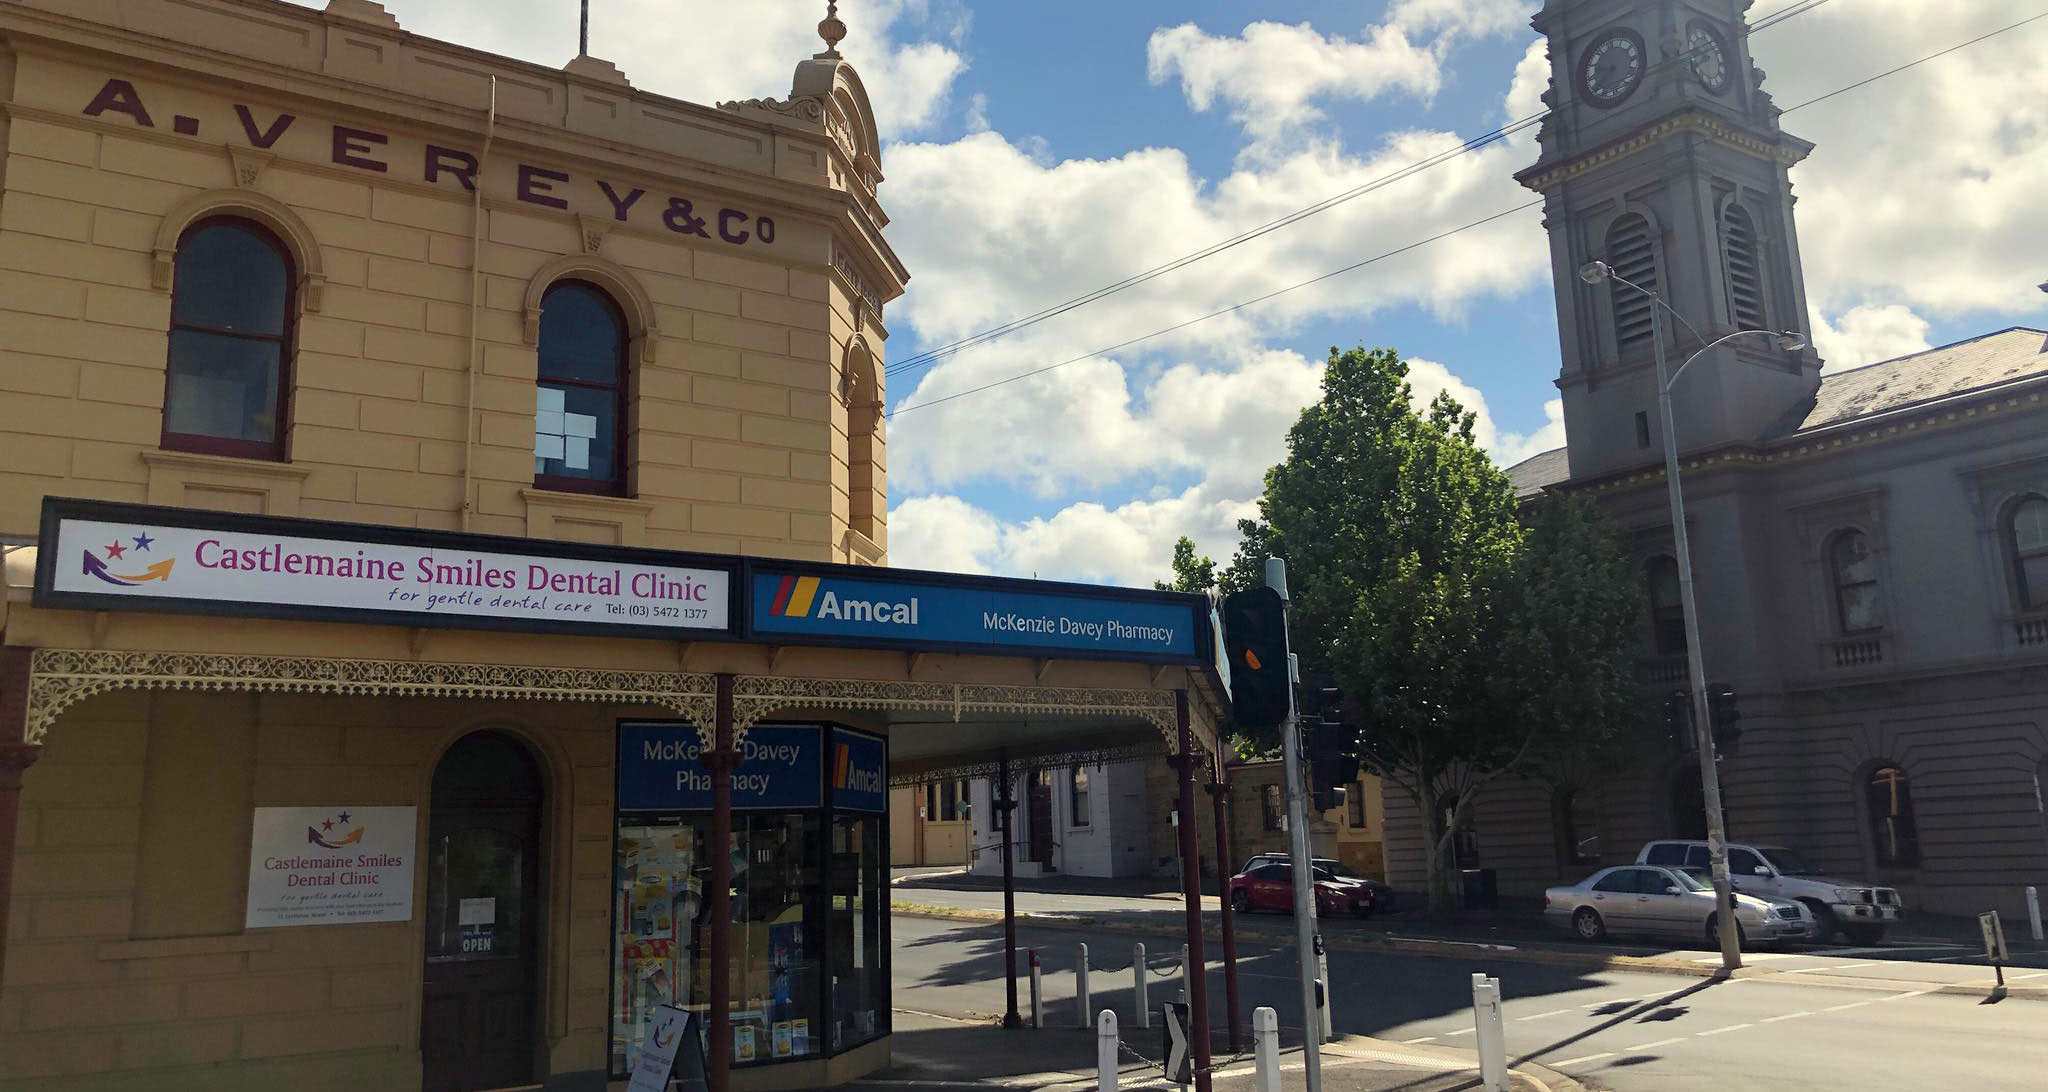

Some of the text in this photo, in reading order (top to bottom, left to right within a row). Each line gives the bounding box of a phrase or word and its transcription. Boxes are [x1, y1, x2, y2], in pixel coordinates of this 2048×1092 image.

[195, 539, 708, 602] Castlemaine Smiles Dental Clinic
[388, 588, 593, 613] for gentle dental care
[605, 603, 709, 620] Tel: (03) 5472 1377
[816, 591, 918, 625] Amcal
[983, 611, 1174, 645] McKenzie Davey Pharmacy
[744, 739, 800, 766] Davey
[848, 759, 882, 793] Amcal
[264, 854, 402, 871] Castlemaine Smiles
[287, 871, 379, 887] Dental Clinic
[463, 937, 491, 952] OPEN
